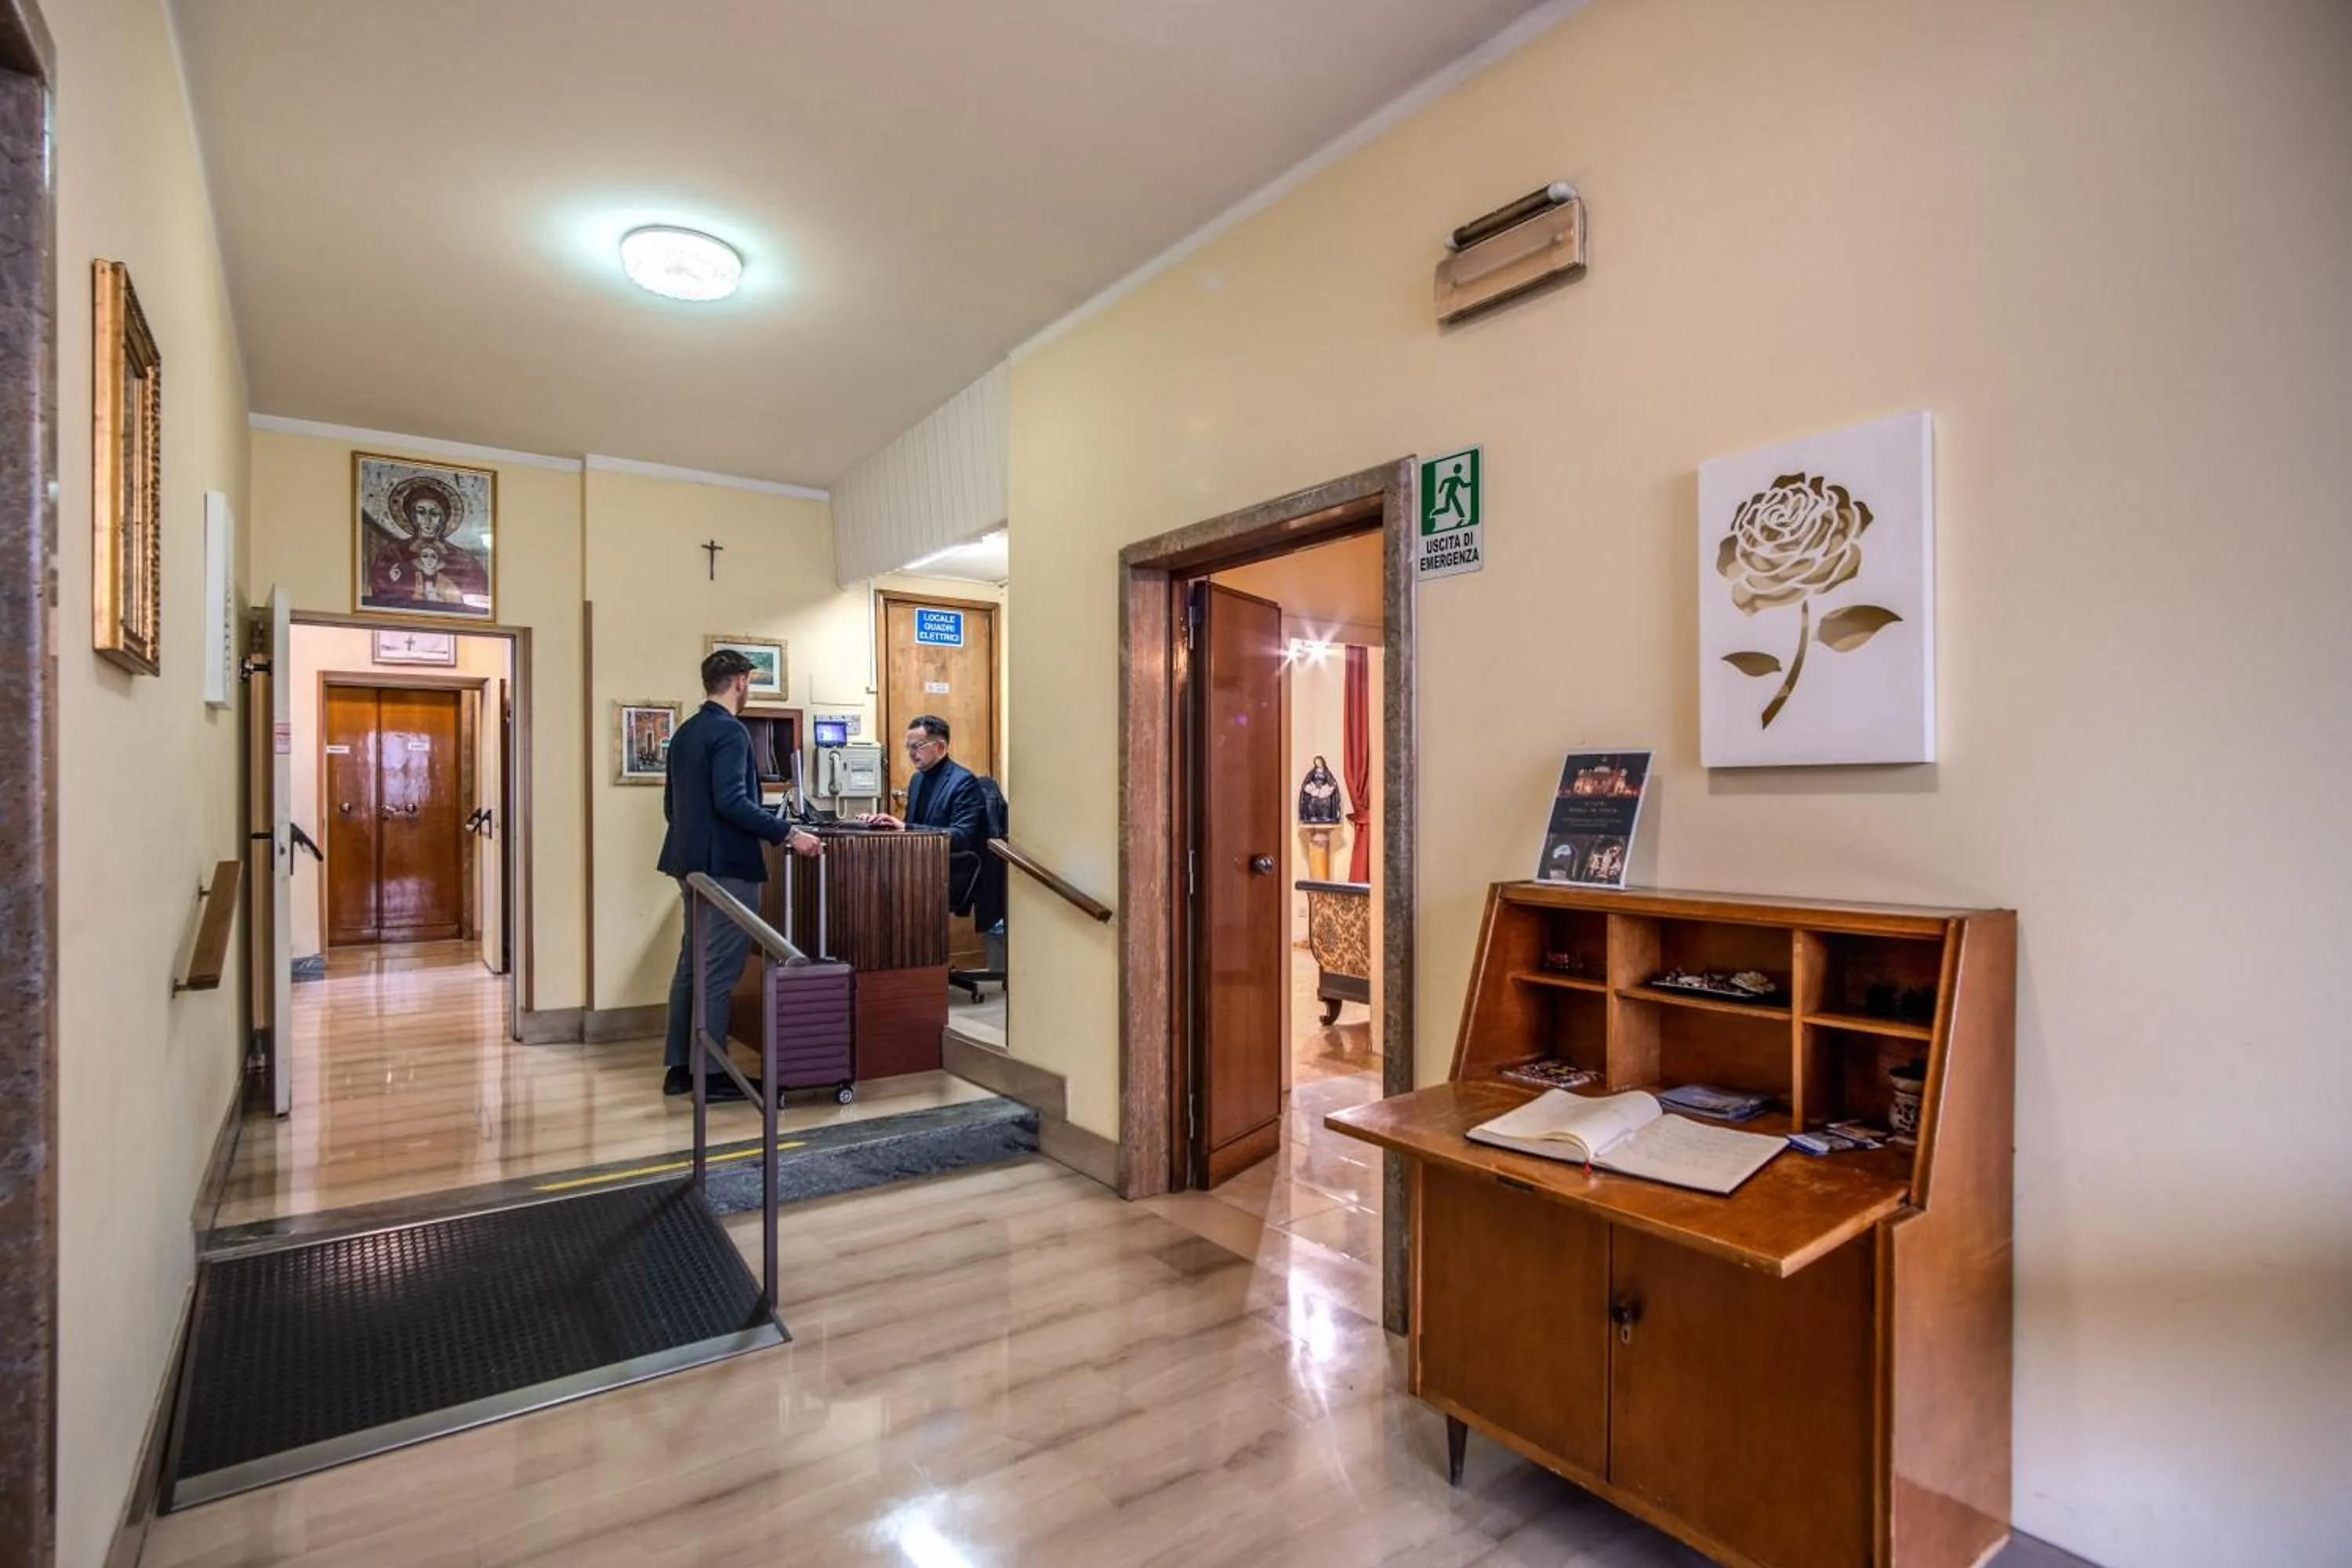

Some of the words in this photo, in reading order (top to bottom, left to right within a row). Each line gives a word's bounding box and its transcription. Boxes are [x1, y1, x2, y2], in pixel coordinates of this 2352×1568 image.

[1426, 535, 1460, 554] USCITA
[1464, 532, 1473, 546] DI
[1420, 547, 1479, 571] EMERGENZA
[923, 612, 955, 622] LOCALE
[924, 622, 955, 632] QUADRI
[920, 631, 959, 642] ELETTRICI
